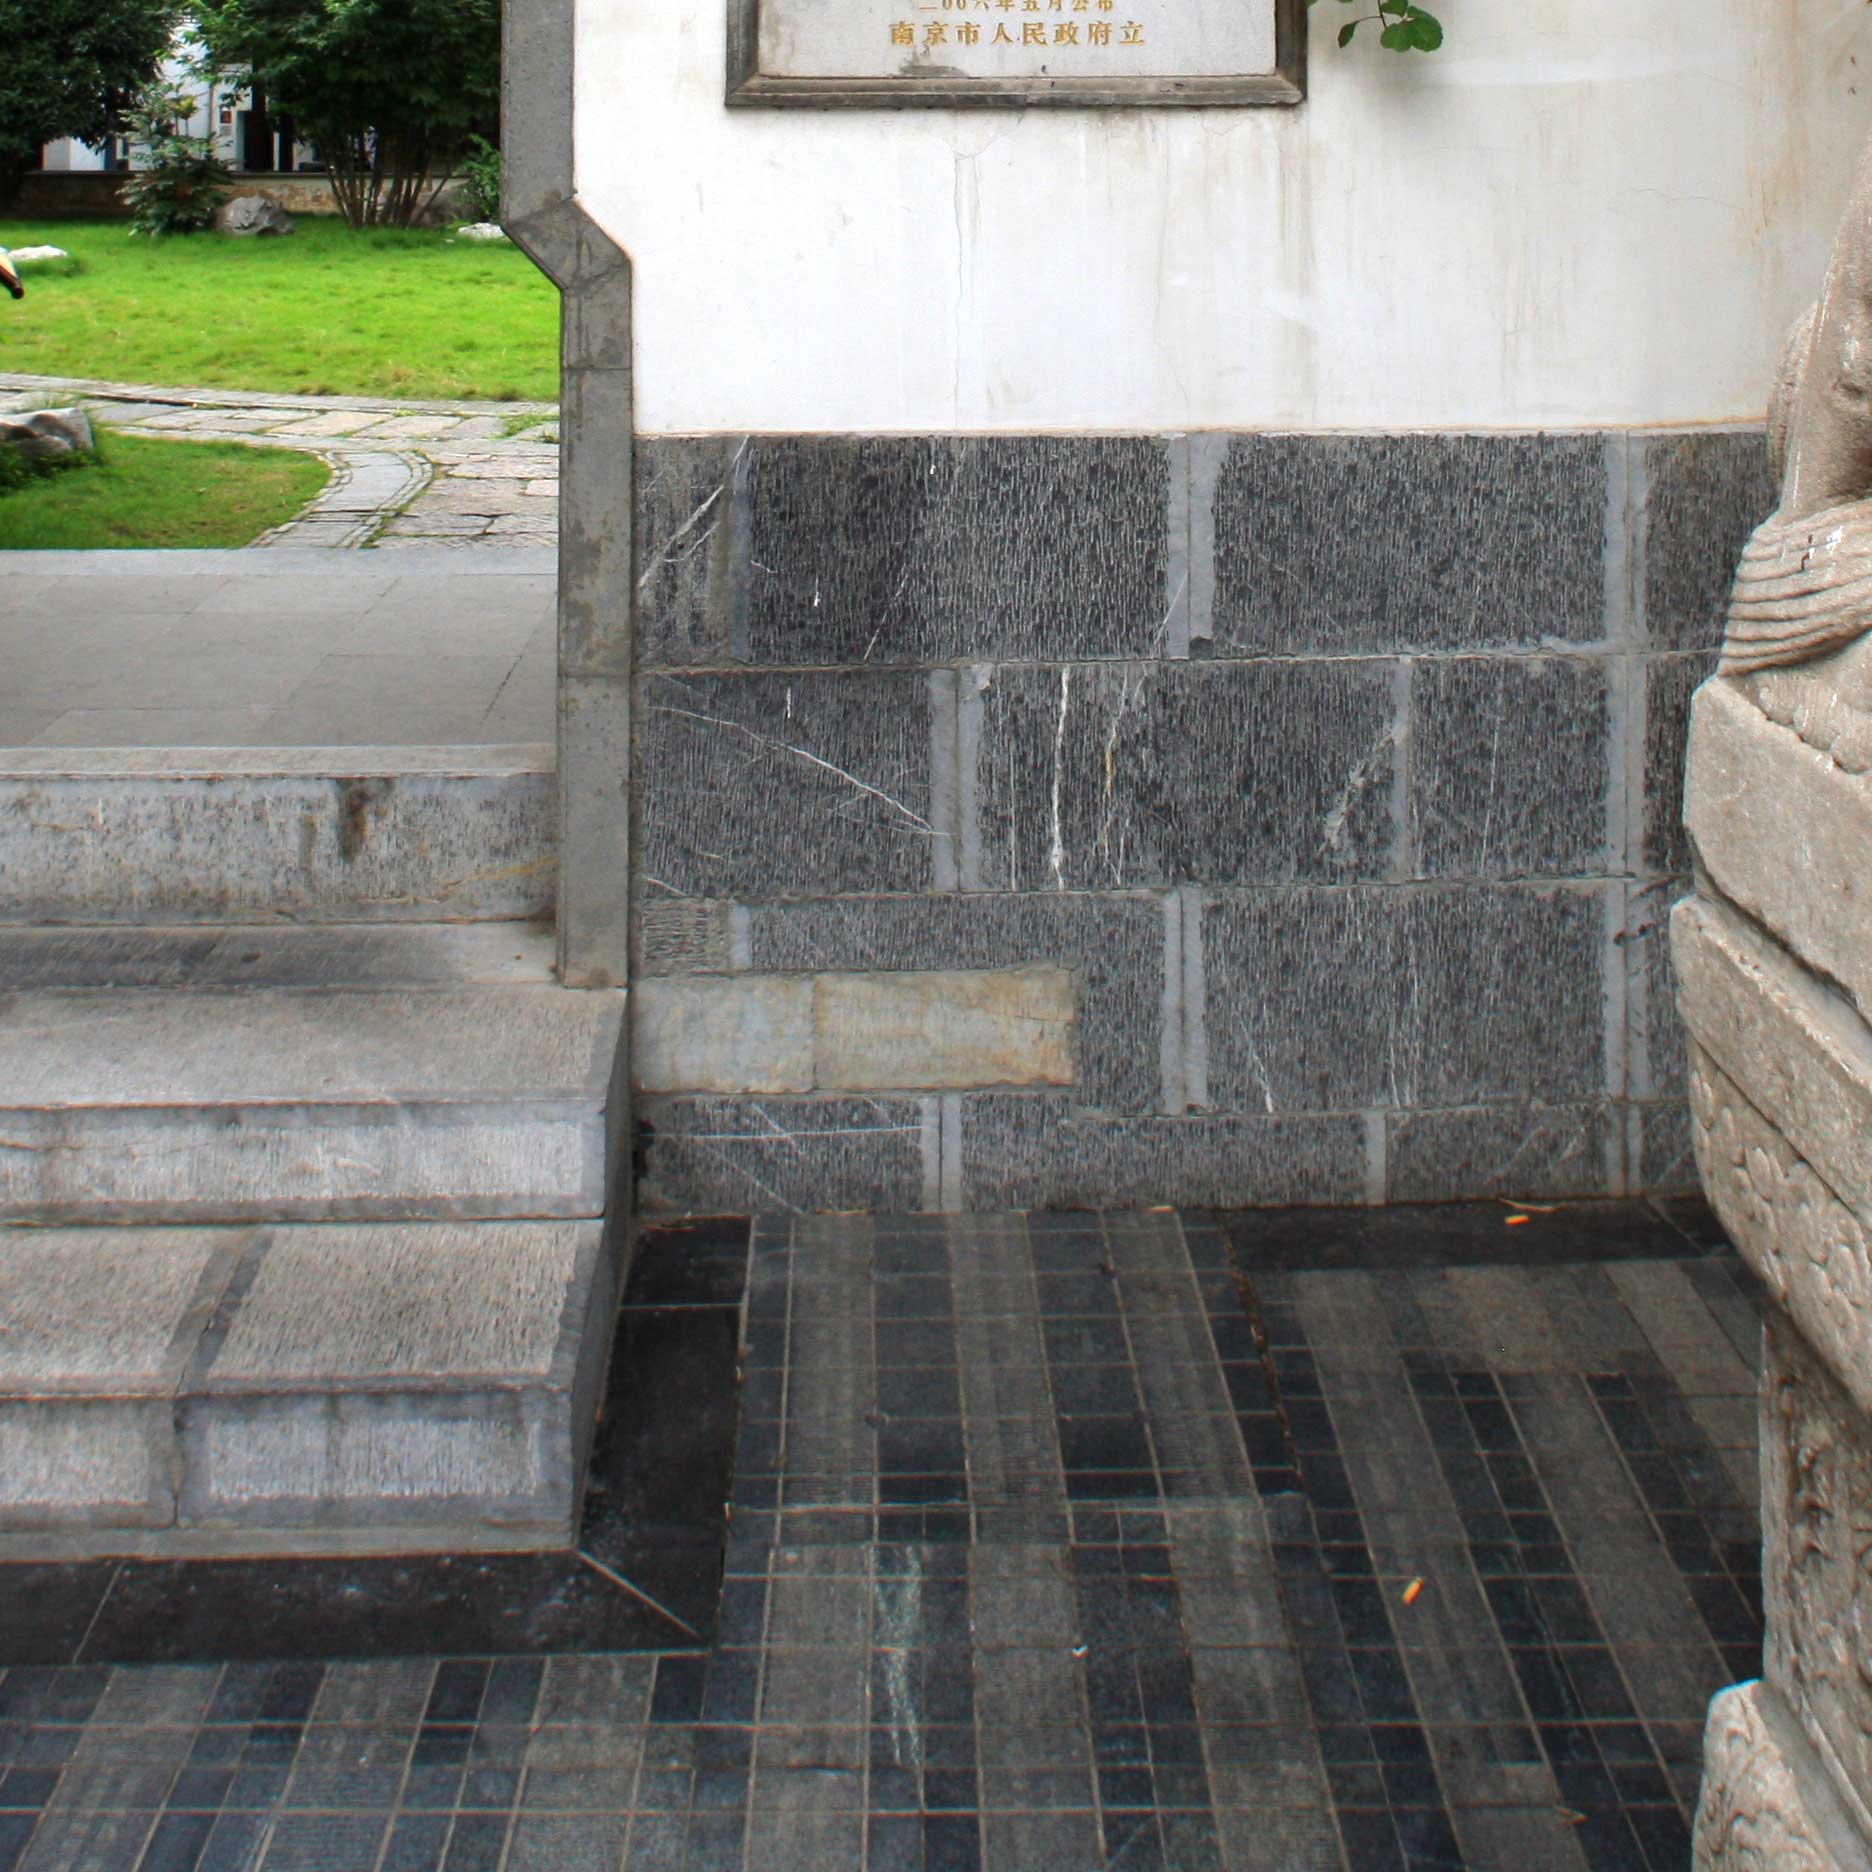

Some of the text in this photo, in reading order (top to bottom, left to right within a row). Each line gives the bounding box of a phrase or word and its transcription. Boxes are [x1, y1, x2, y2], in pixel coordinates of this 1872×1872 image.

[889, 20, 1145, 47] 南京市人民政府立
